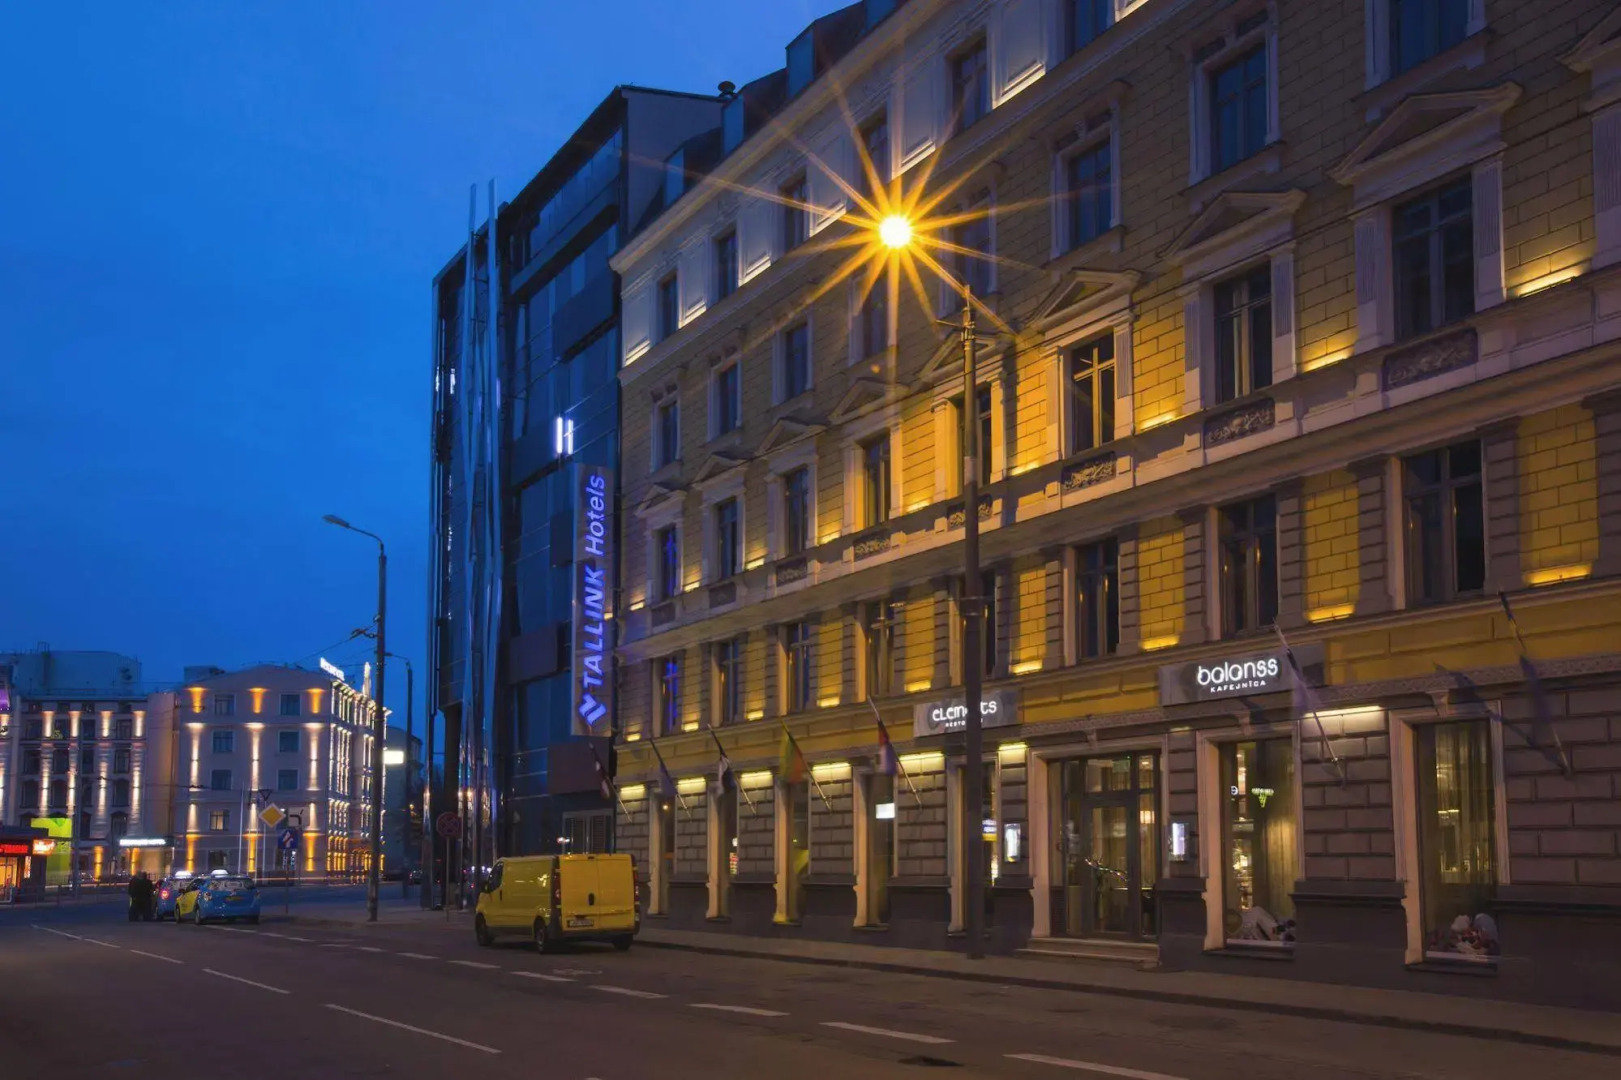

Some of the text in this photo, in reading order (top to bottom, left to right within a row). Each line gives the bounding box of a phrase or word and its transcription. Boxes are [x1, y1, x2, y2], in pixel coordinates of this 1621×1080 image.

[583, 474, 606, 688] TALLINK Hotels
[1197, 658, 1278, 685] balanss
